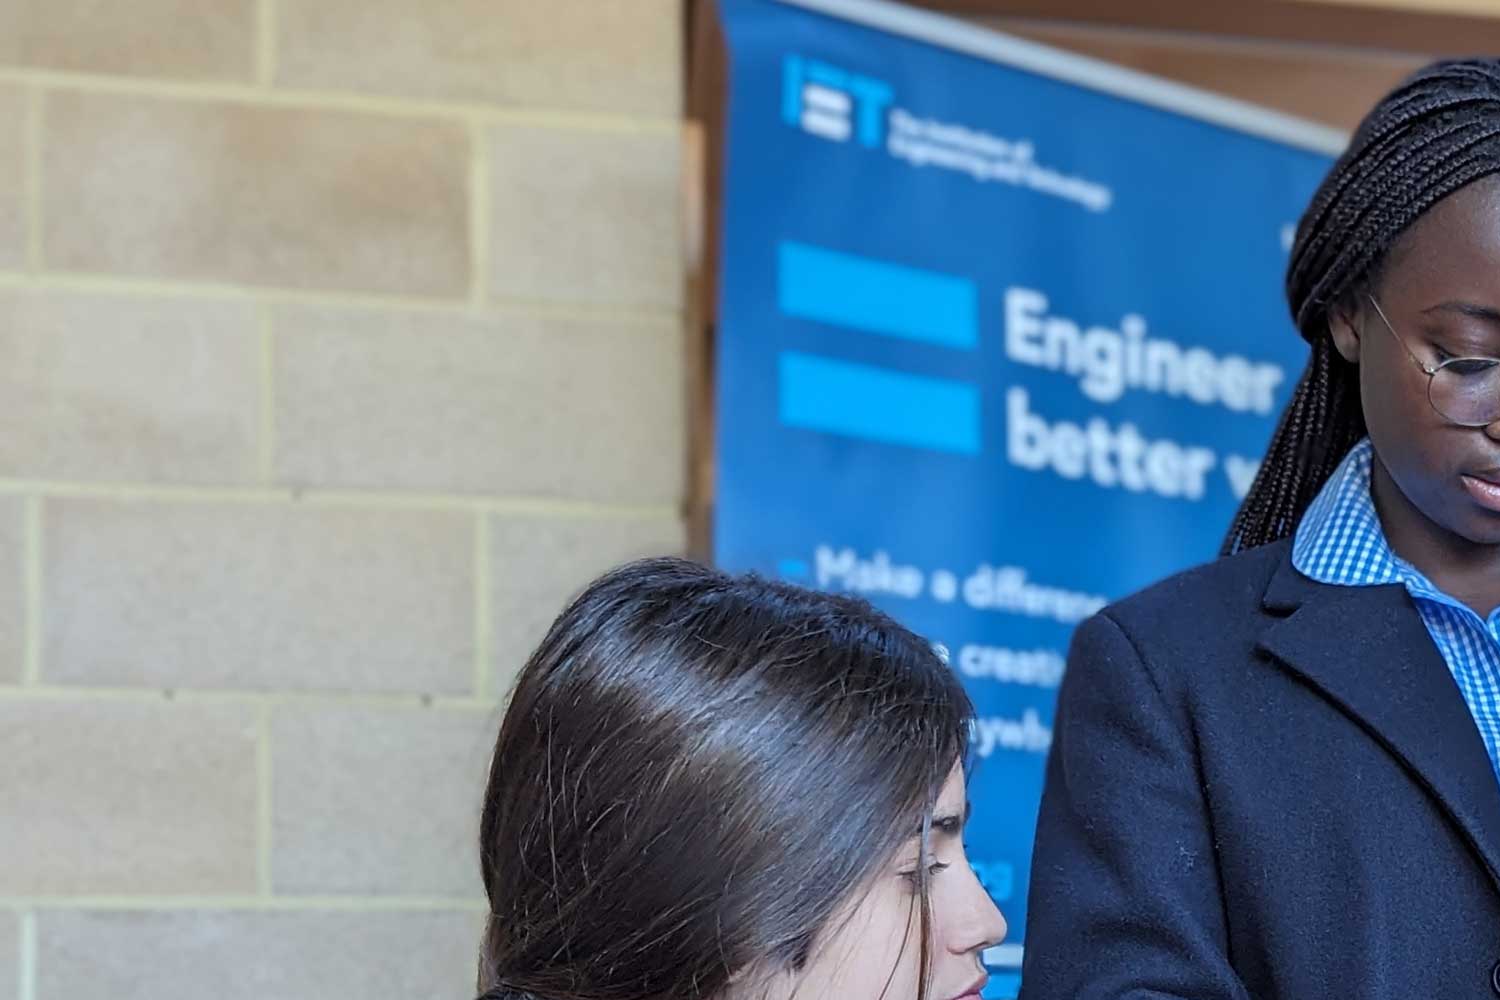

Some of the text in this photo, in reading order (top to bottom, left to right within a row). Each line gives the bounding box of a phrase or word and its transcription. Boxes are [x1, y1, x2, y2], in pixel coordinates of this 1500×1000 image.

[1004, 286, 1285, 416] Engineer
[1006, 384, 1217, 502] better
[815, 545, 925, 599] Make
[930, 568, 958, 602] a
